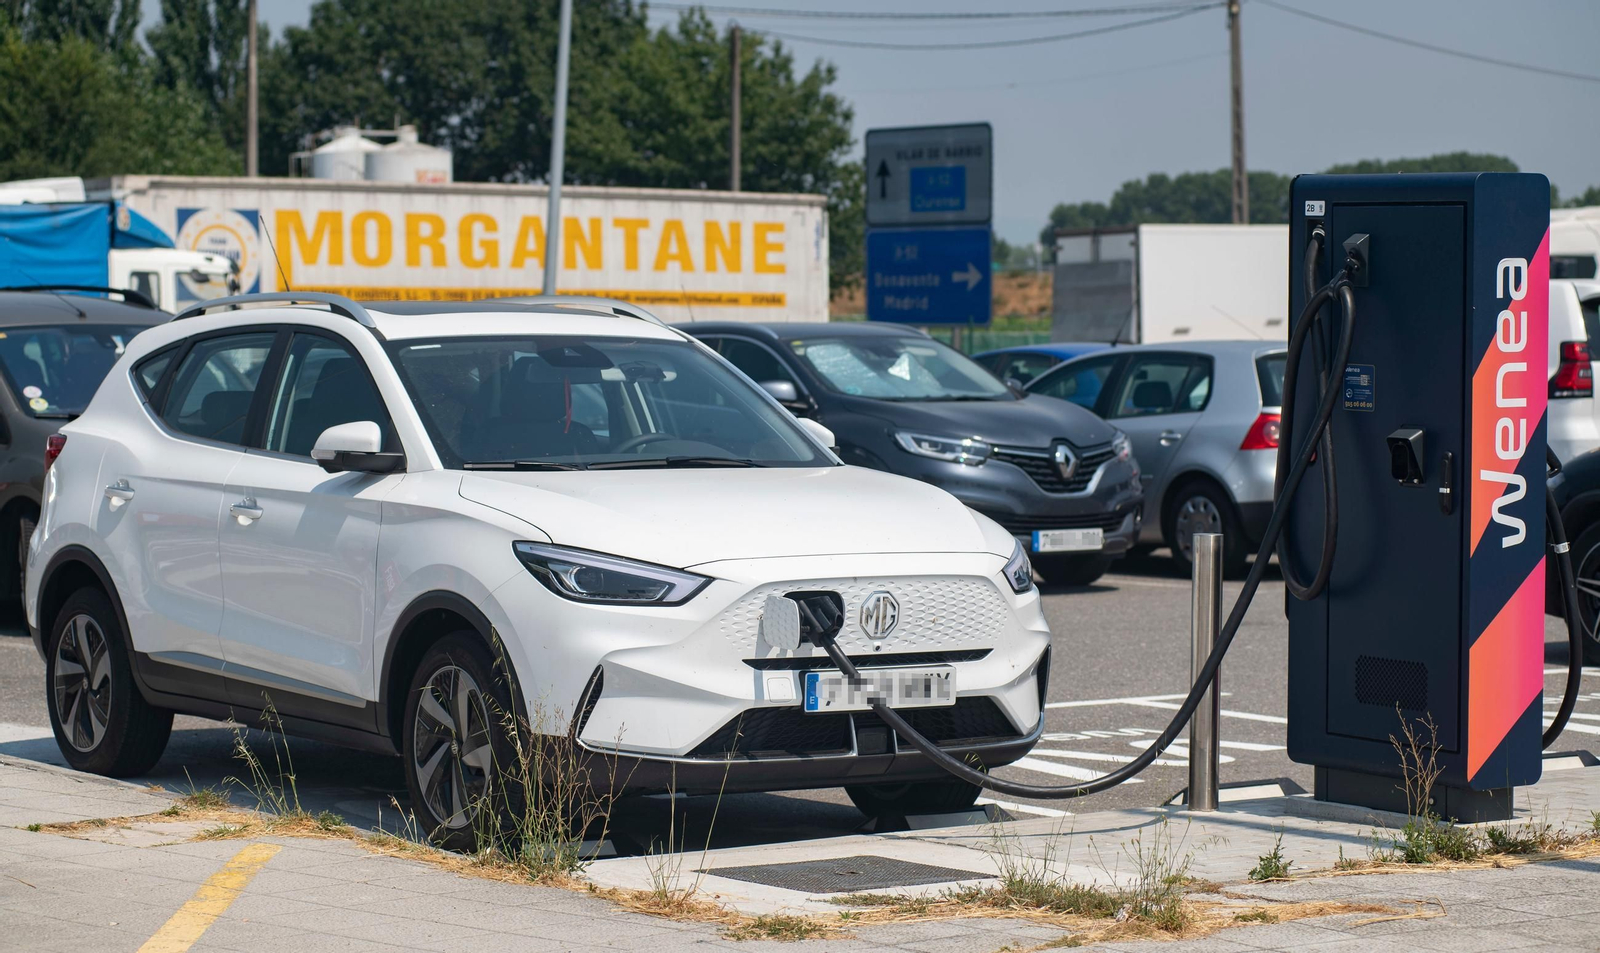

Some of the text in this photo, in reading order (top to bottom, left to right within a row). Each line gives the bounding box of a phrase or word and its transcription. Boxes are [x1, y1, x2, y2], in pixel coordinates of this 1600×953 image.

[1306, 203, 1316, 213] 2B
[275, 209, 786, 274] MORGANTANE
[884, 295, 929, 311] Madrid
[864, 596, 896, 635] MG
